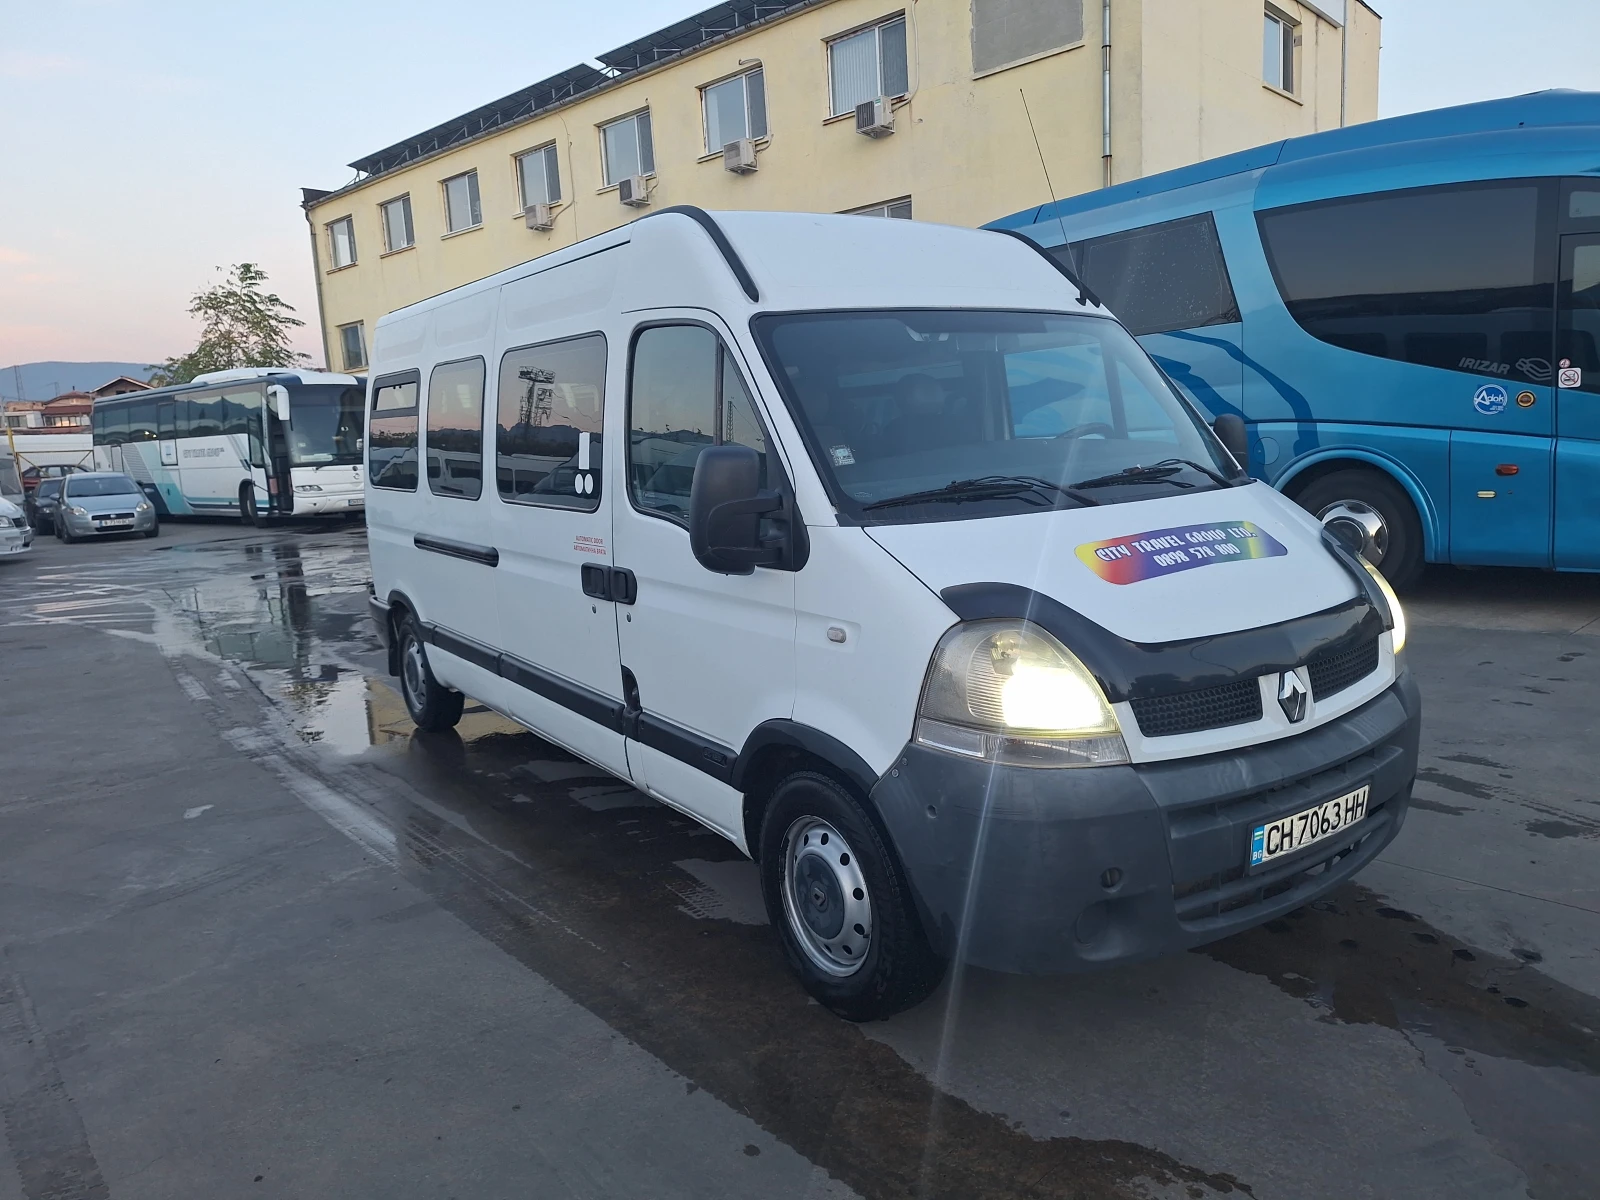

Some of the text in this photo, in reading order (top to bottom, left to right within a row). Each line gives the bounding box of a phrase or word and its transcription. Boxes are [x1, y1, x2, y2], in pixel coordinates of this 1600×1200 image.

[1458, 357, 1511, 375] IRIZAR
[1474, 389, 1505, 406] Adok
[576, 535, 593, 543] AUTOMATIC
[1095, 544, 1132, 561] CITY
[1131, 535, 1186, 553] TRAVEL
[1184, 528, 1227, 543] GROUP
[1152, 542, 1241, 567] 0898 578 800
[1252, 849, 1263, 861] BG
